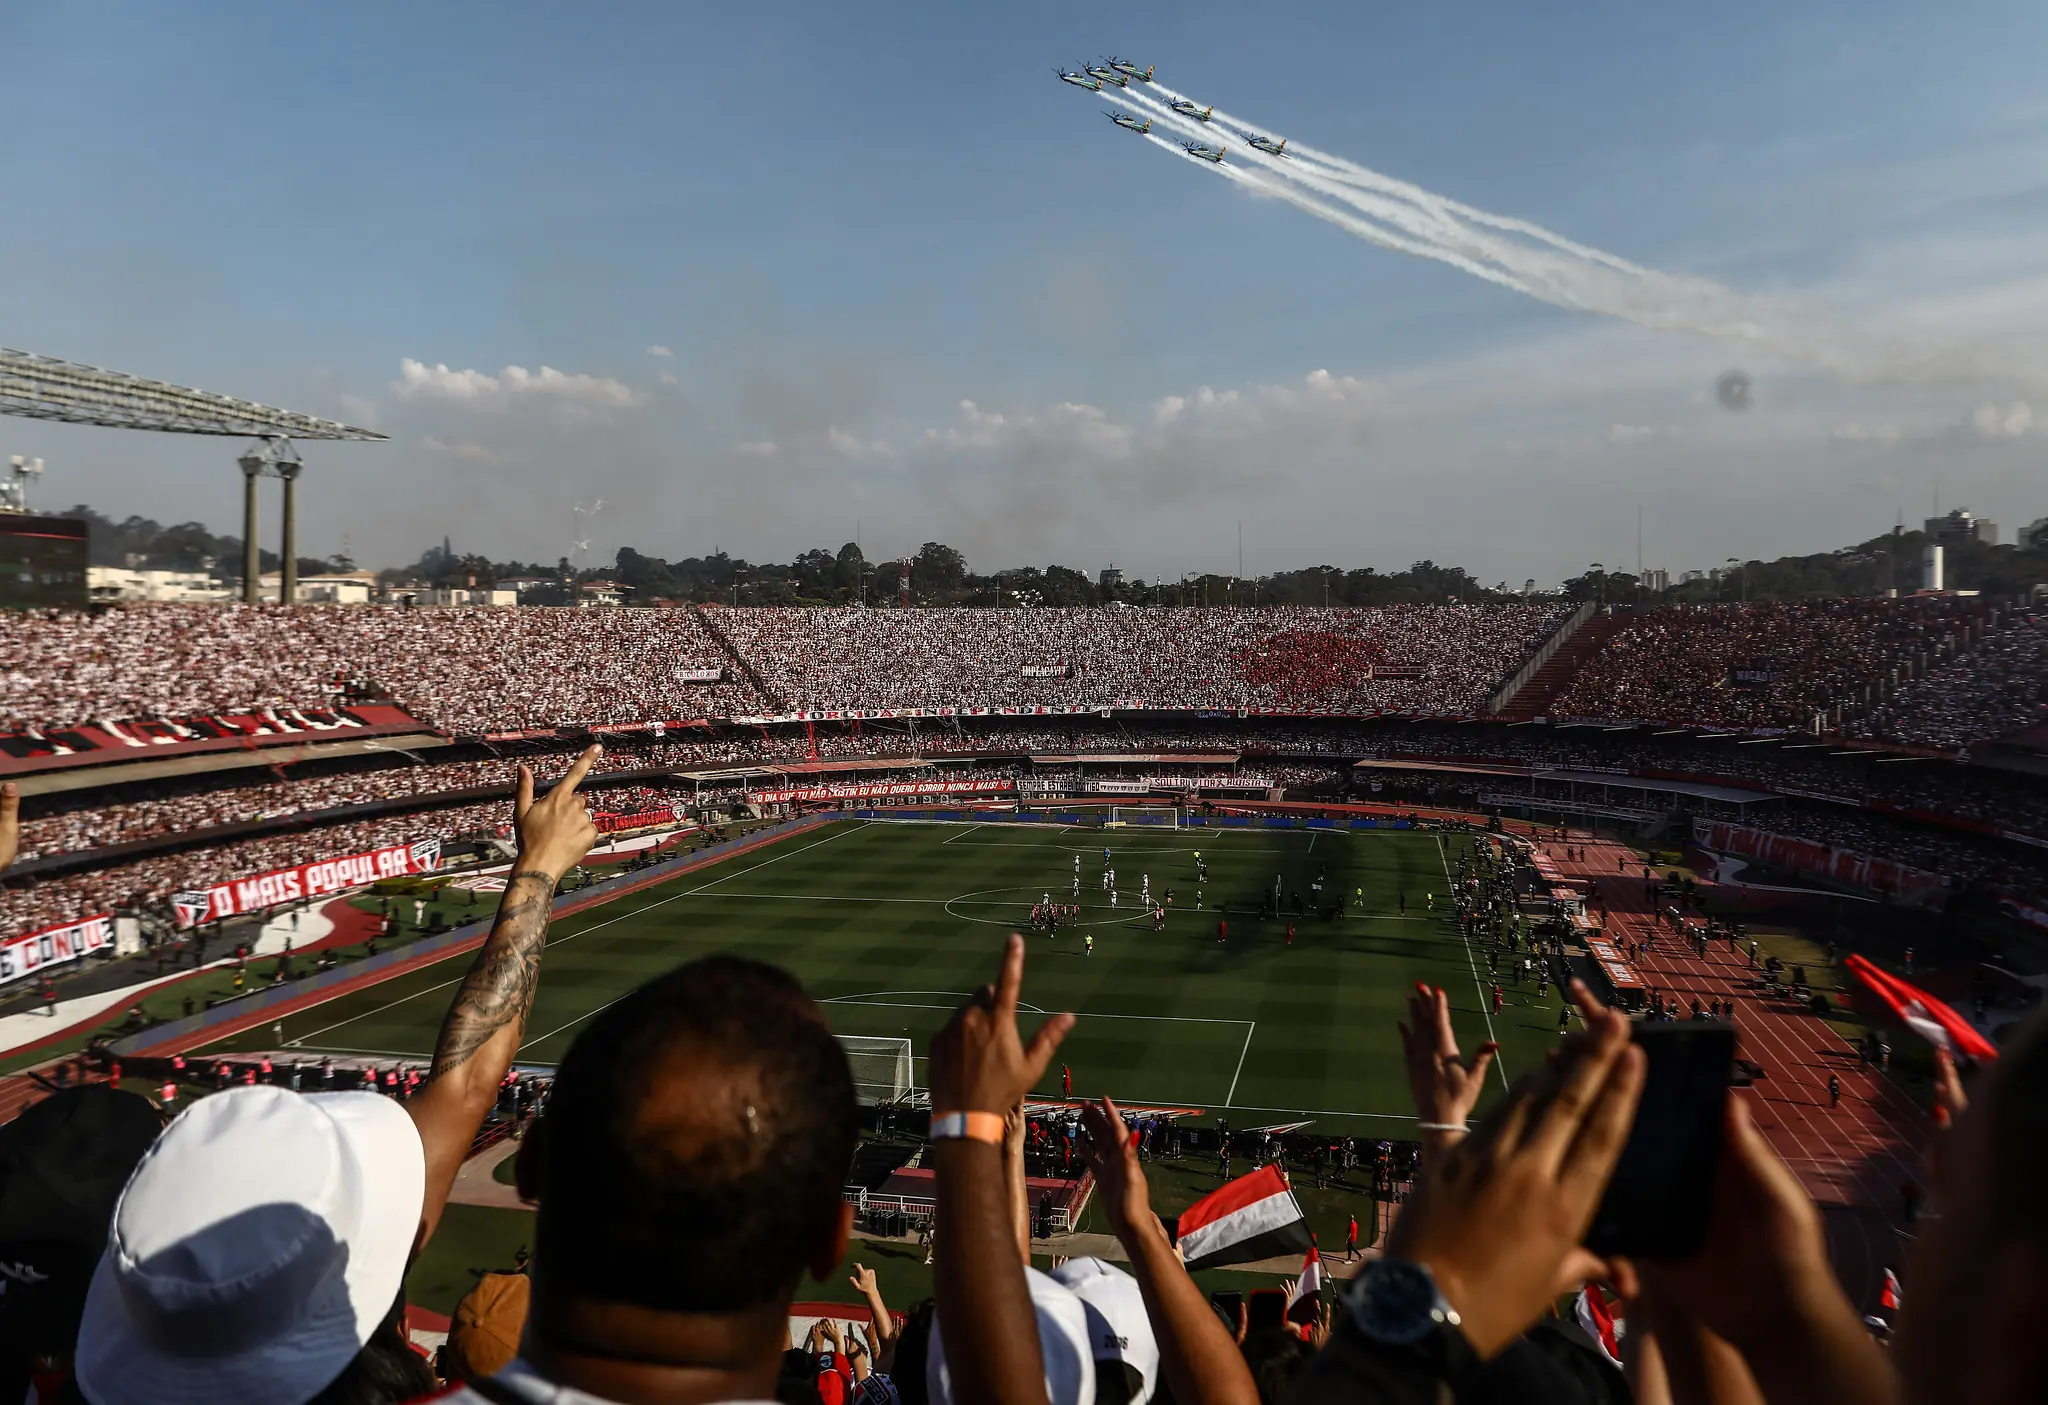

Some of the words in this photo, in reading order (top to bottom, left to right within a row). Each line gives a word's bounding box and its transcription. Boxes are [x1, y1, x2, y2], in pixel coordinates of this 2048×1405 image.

[794, 709, 894, 720] TORCIDA
[757, 793, 763, 803] O
[765, 792, 778, 802] DIA
[797, 791, 808, 800] TU
[809, 789, 826, 799] NÃO
[859, 786, 870, 795] EU
[871, 784, 889, 795] NÃO
[890, 784, 916, 794] QUERO
[917, 783, 946, 792] SORRIR
[946, 782, 974, 791] NUNCA
[976, 781, 1000, 790] MAIS!
[1018, 780, 1046, 791] SEMPRE
[213, 886, 235, 917] O
[236, 870, 302, 910] MAIS
[304, 848, 410, 896] POPULAR
